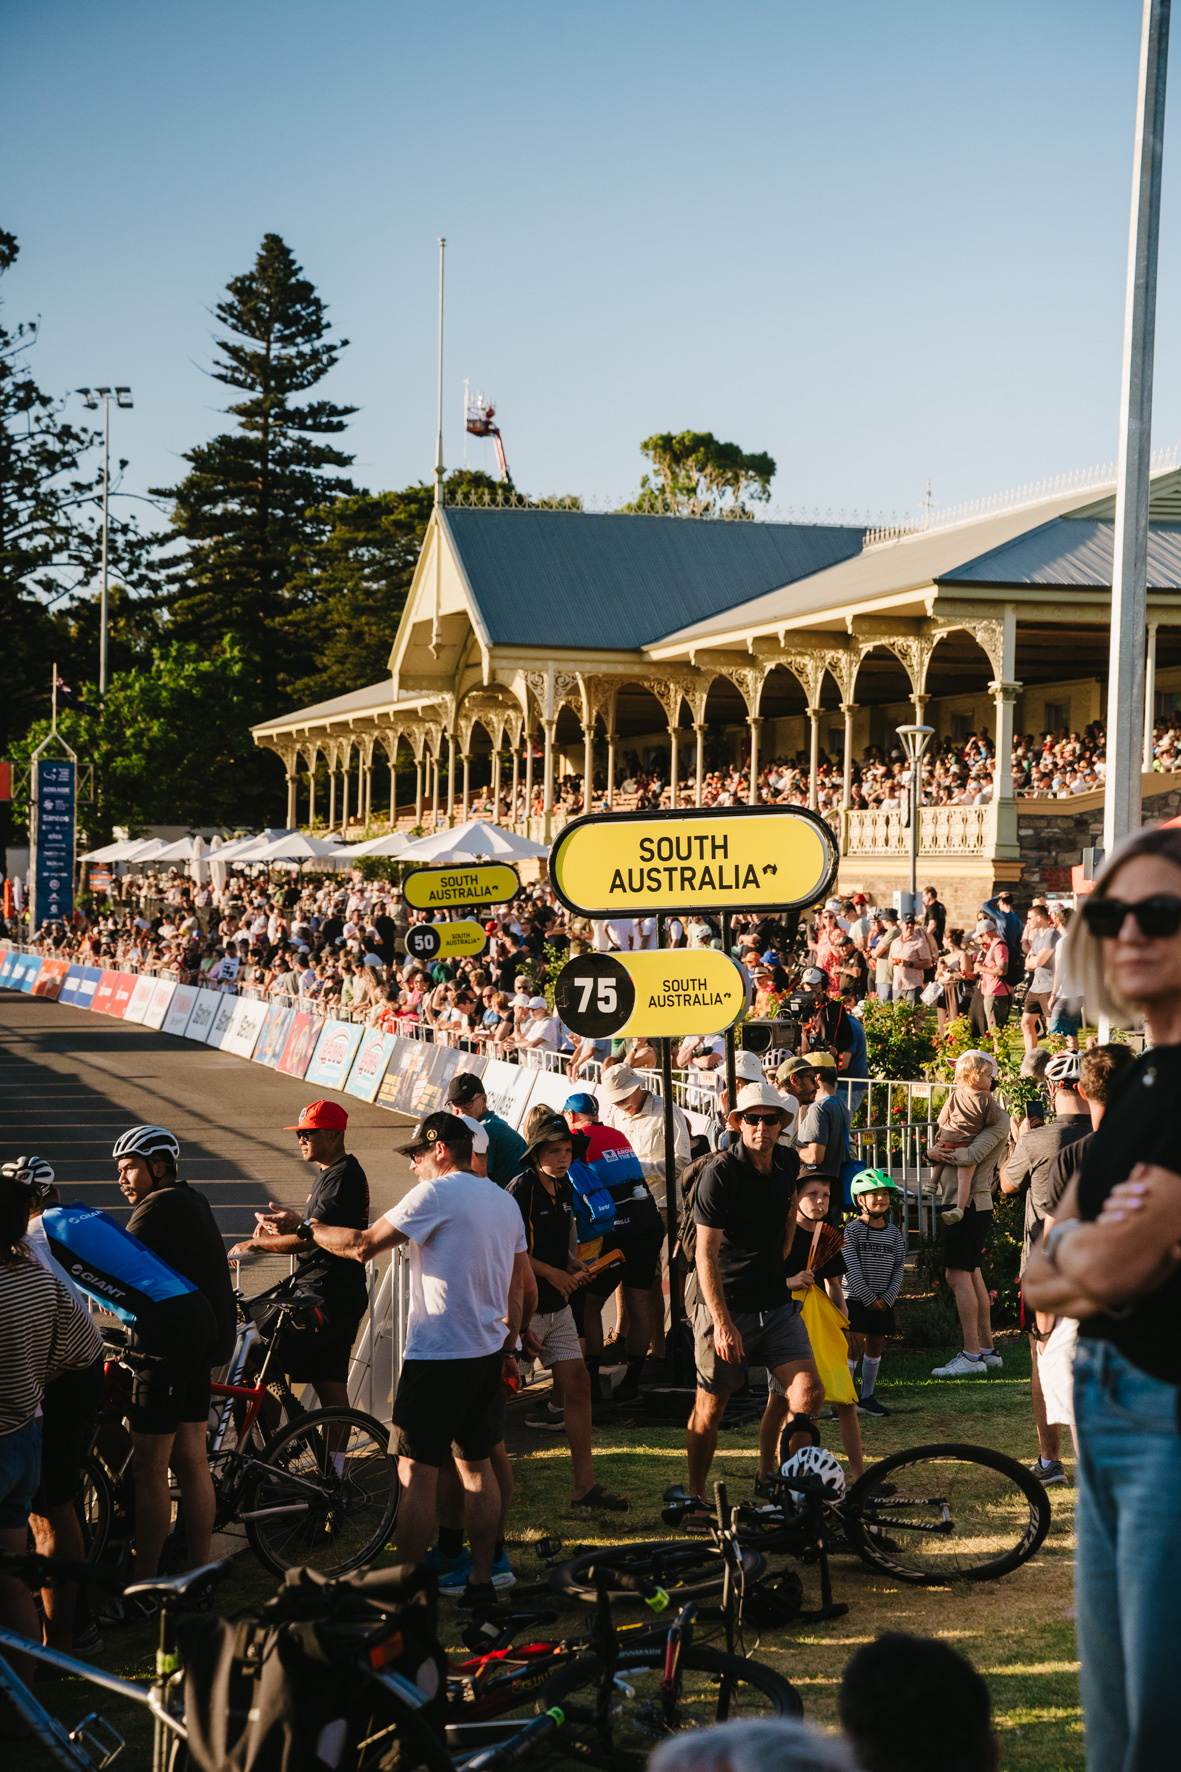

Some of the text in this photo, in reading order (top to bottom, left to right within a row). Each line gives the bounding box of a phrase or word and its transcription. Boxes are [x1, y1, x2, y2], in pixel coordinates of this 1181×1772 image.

[639, 834, 729, 862] SOUTH
[440, 874, 479, 888] SOUTH
[609, 864, 761, 894] AUSTRALIA
[429, 885, 492, 901] AUSTRALIA
[414, 934, 434, 950] 50
[445, 938, 478, 946] AUSTRALIA
[451, 932, 471, 940] SOUTH
[662, 978, 708, 992] SOUTH
[573, 977, 618, 1014] 75
[648, 992, 724, 1008] AUSTRALIA
[80, 1210, 104, 1220] GIAN
[80, 1271, 127, 1299] GIANT
[217, 1366, 245, 1437] CANON
[1018, 1502, 1040, 1556] ZIPP
